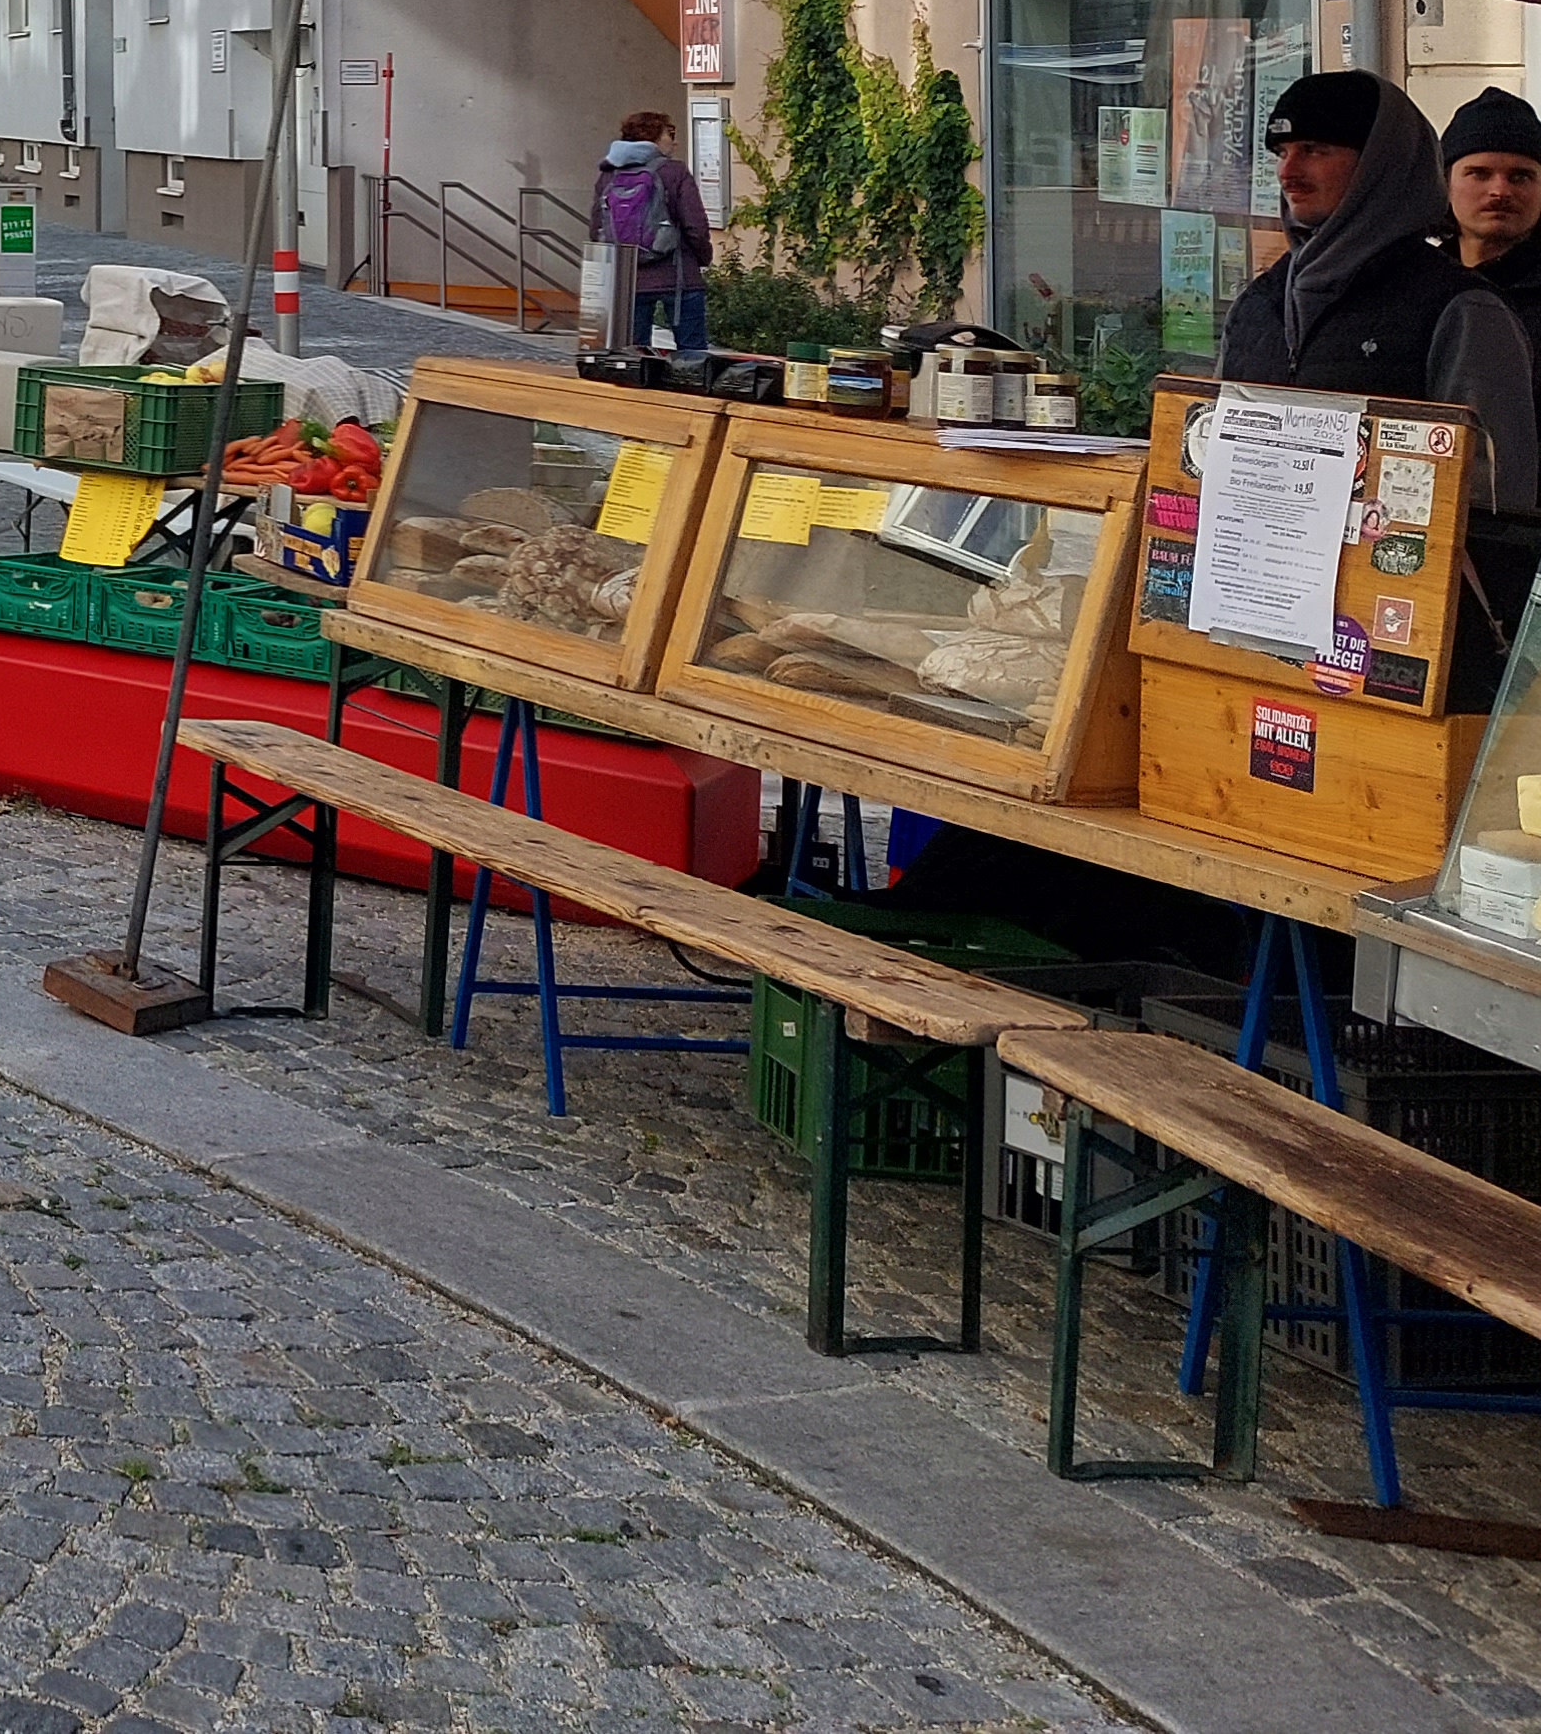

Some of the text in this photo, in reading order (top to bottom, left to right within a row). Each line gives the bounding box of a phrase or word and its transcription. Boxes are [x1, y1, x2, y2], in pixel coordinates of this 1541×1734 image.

[685, 44, 720, 73] ZEHN
[1174, 229, 1203, 246] YOGA
[1313, 428, 1344, 441] 2022
[1180, 552, 1194, 566] FÜ
[1349, 637, 1367, 654] DIE
[1255, 705, 1312, 732] SOLIDARITÄT
[1255, 720, 1275, 740] MIT
